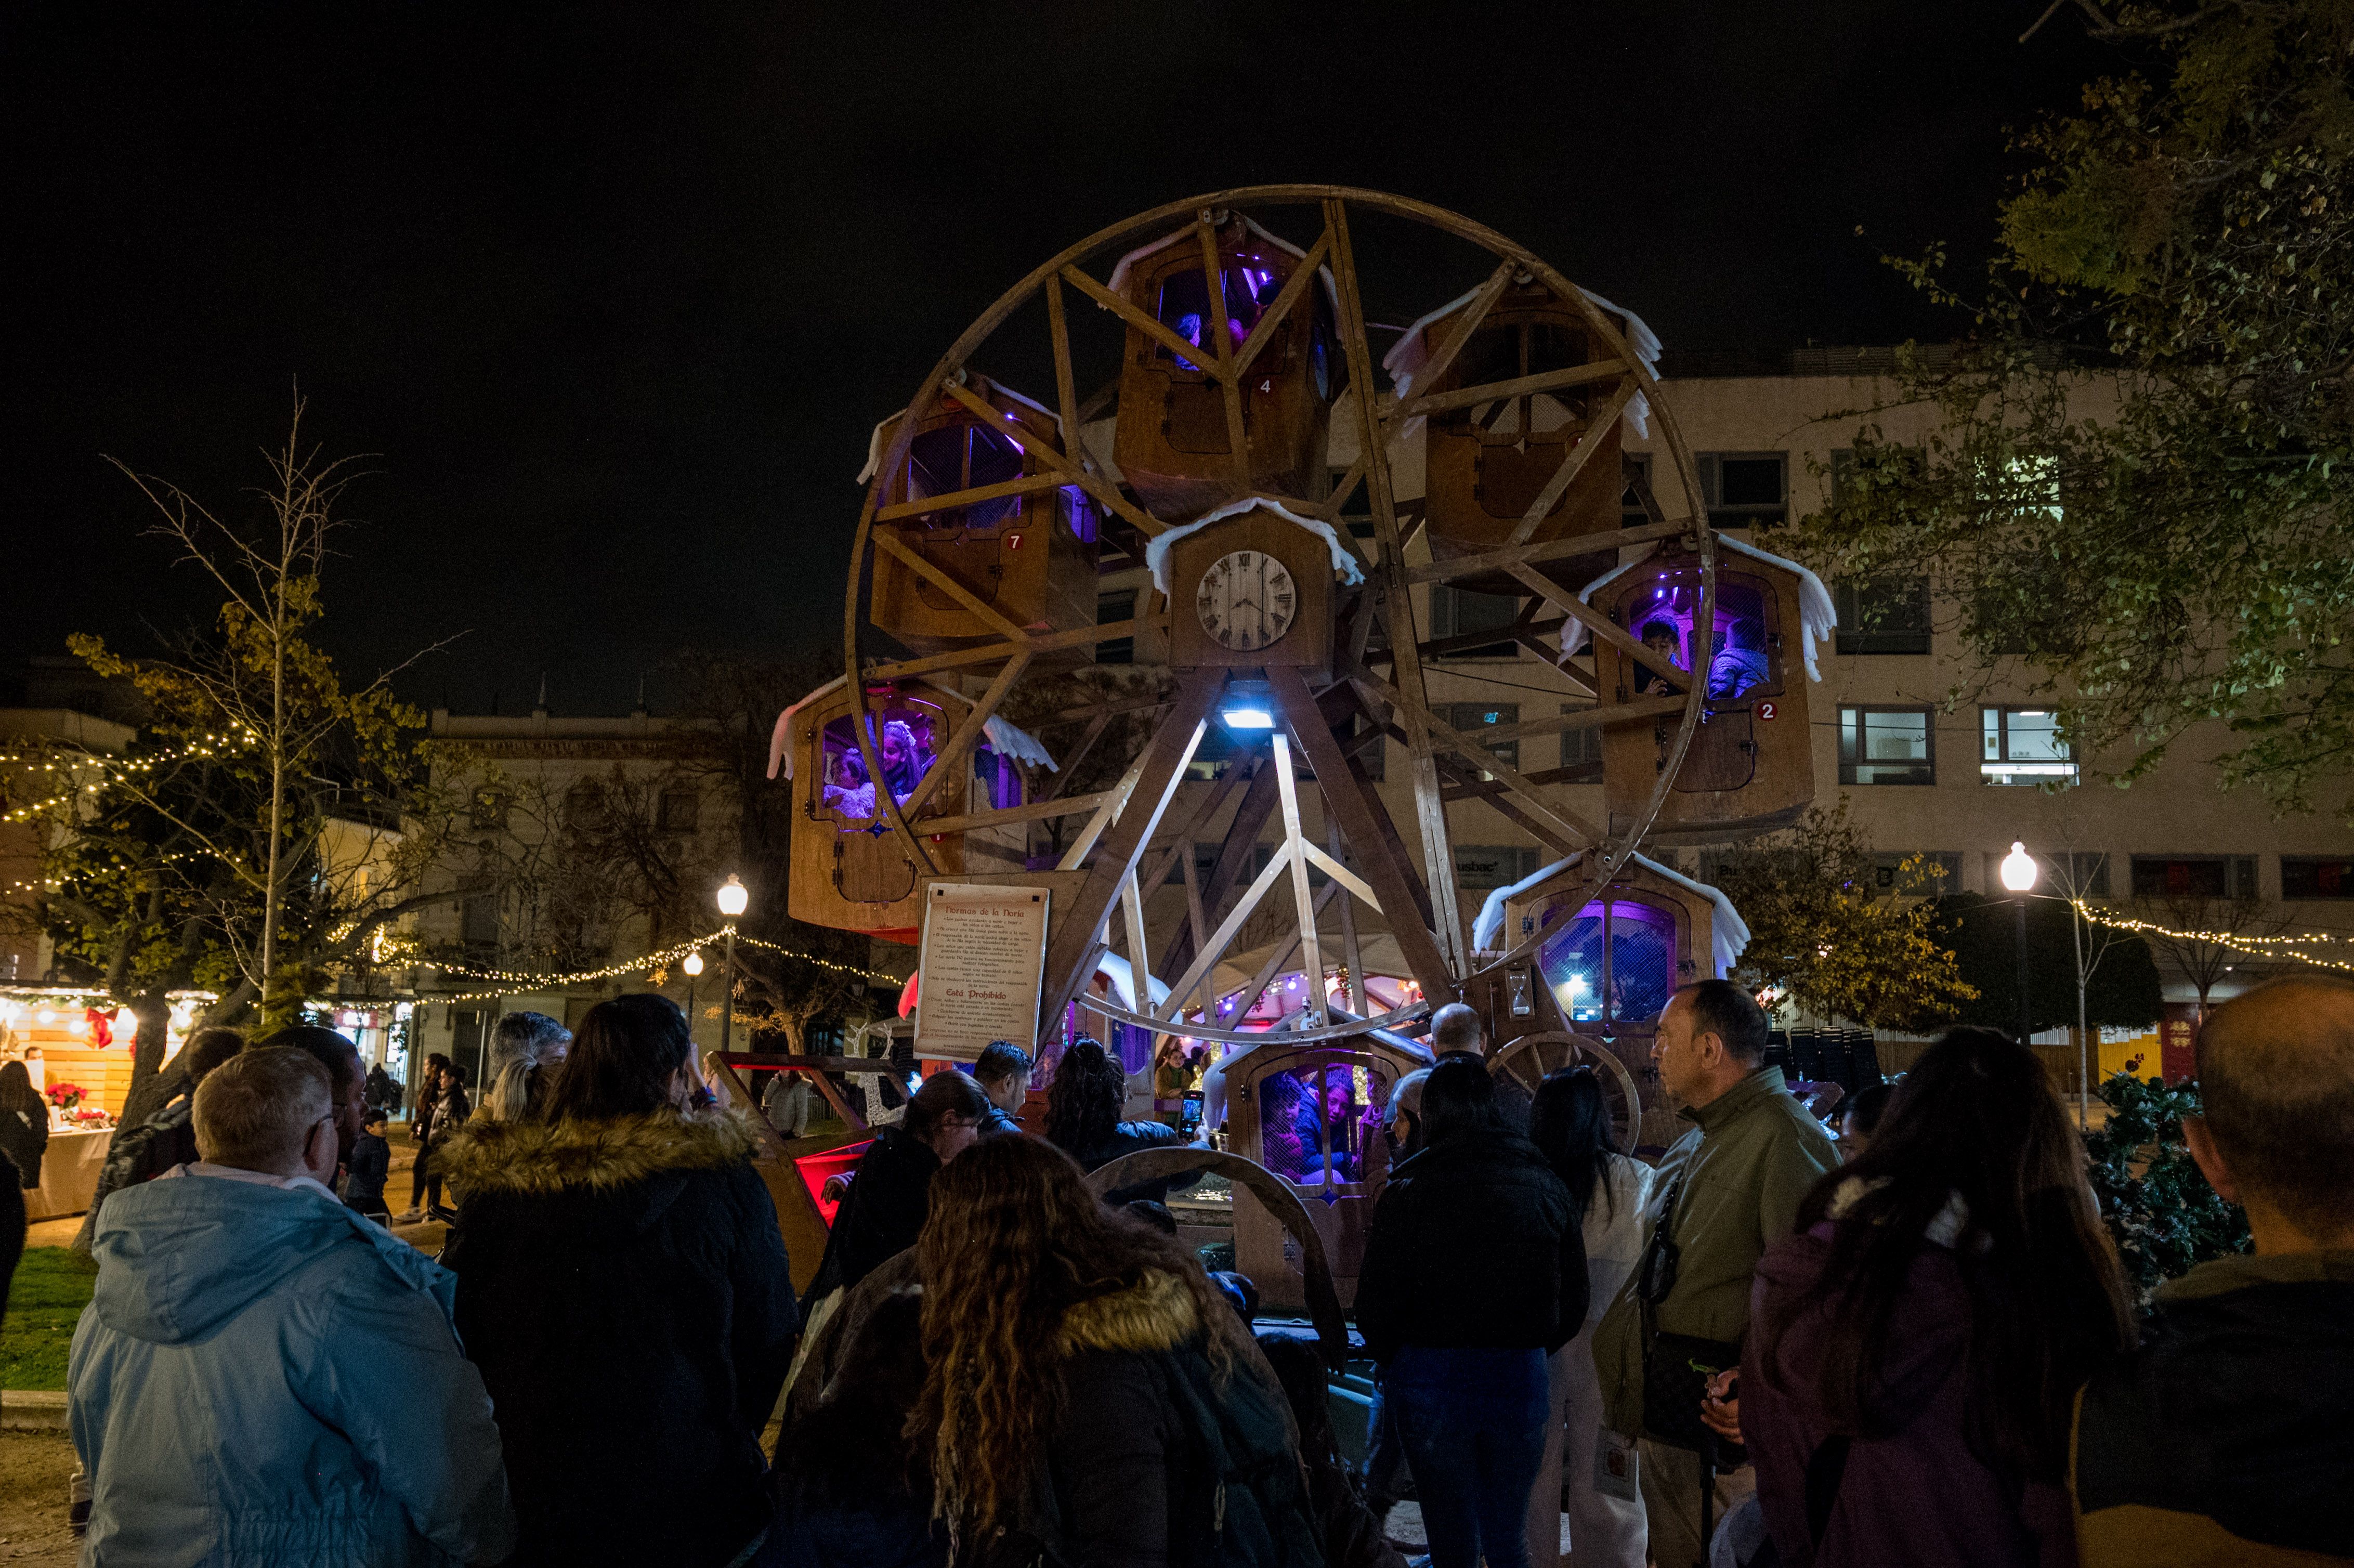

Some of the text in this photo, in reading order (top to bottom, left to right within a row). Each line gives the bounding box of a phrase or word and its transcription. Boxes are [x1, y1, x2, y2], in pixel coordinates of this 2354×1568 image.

[1260, 380, 1271, 394] 4
[1011, 535, 1020, 548] 7
[1238, 553, 1250, 567] XII
[1762, 703, 1774, 720] 2
[945, 906, 977, 914] Normas
[979, 907, 989, 916] de
[945, 988, 964, 997] Está
